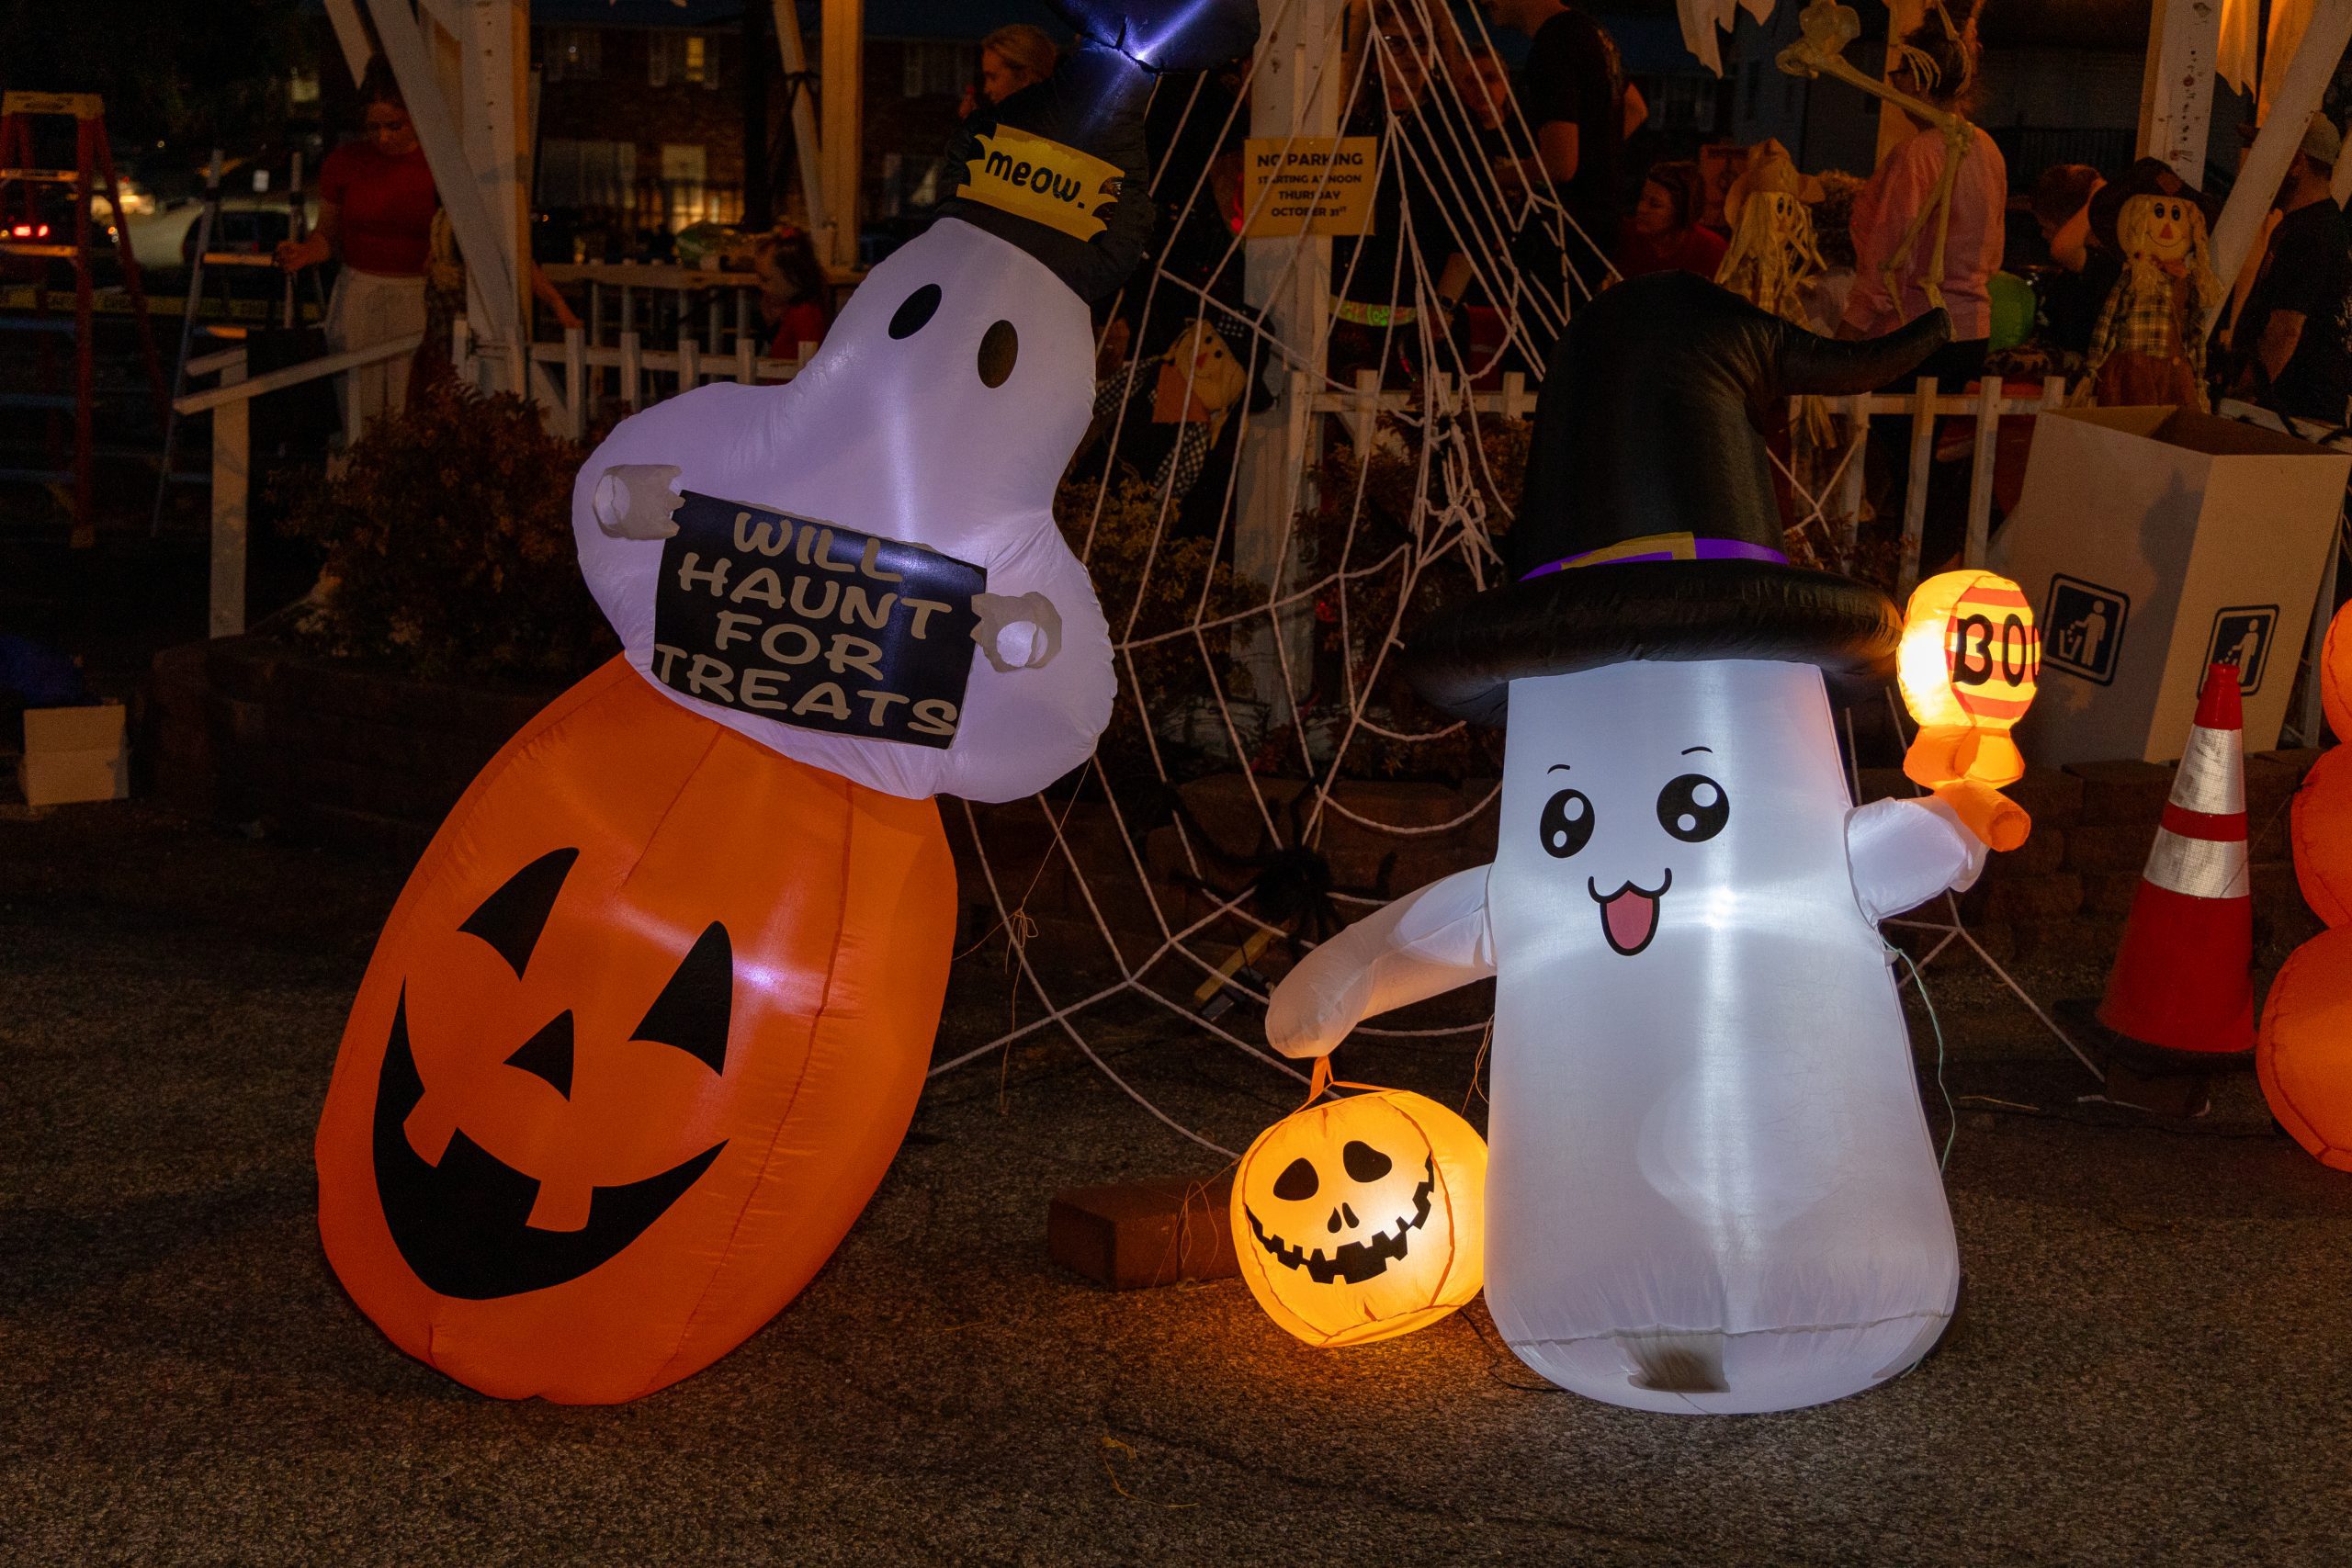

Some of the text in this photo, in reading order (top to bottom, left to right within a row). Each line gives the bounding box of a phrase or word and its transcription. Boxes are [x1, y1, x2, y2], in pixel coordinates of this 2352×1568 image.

[985, 151, 1085, 209] meow.
[1257, 153, 1281, 167] NO
[1329, 174, 1362, 184] NOON
[734, 512, 903, 581] WILL
[678, 552, 953, 639] HAUNT
[715, 610, 884, 681] FOR
[655, 643, 958, 736] TREATS
